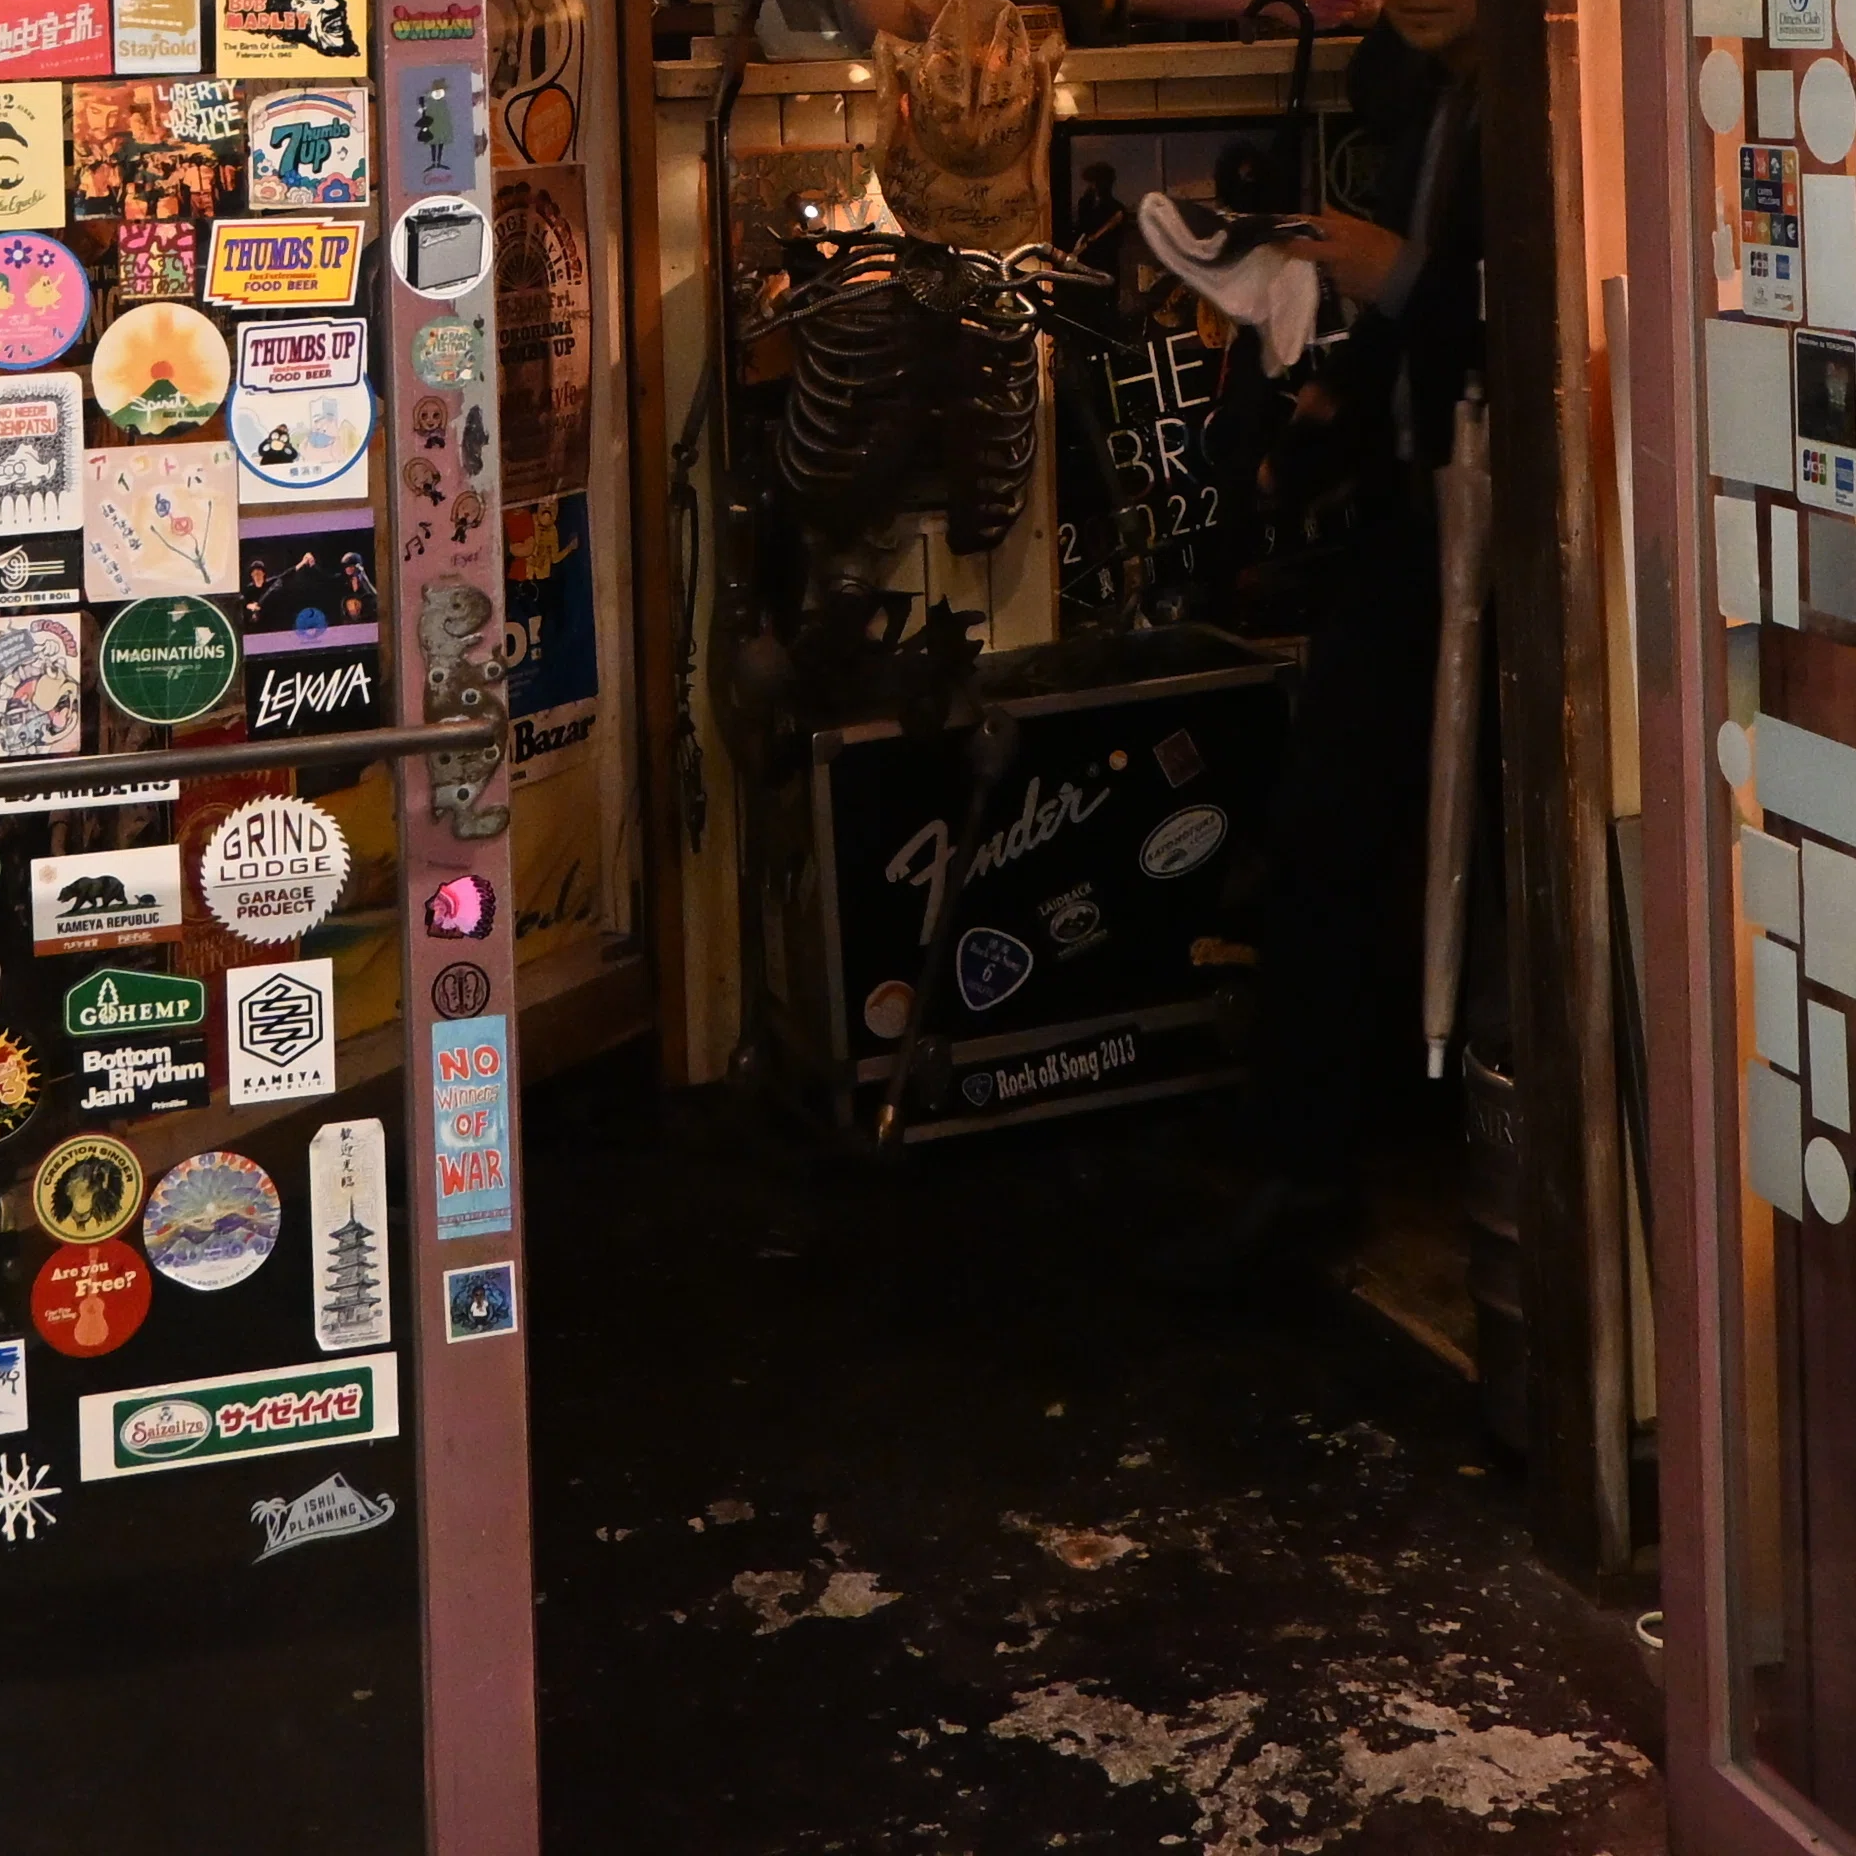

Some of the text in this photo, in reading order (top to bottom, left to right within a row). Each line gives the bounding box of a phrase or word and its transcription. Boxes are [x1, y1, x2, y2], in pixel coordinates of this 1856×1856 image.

[225, 12, 311, 30] MARLEY
[1779, 12, 1821, 24] Diners Club
[118, 40, 197, 59] StayGold
[157, 80, 237, 102] LIBERTY
[243, 279, 319, 292] FOOD BEER
[269, 369, 332, 383] FOOD BEER
[110, 644, 225, 663] IMAGINATIONS
[255, 662, 371, 729] LEYONA
[222, 808, 328, 860] GRIND
[220, 856, 332, 882] LODGE
[237, 886, 314, 905] GARAGE
[236, 900, 314, 919] PROJECT
[56, 912, 161, 934] KAMEYA REPUBLIC
[82, 1047, 172, 1073] Bottom
[438, 1044, 501, 1081] NO
[996, 1063, 1037, 1100] Rock
[1061, 1050, 1099, 1081] Song
[1102, 1035, 1137, 1070] 2013
[109, 1059, 205, 1090] Rhythm
[243, 1070, 322, 1089] KAMEYA
[81, 1088, 135, 1110] Jam
[455, 1111, 488, 1136] OF
[437, 1148, 506, 1198] WAR
[75, 1270, 137, 1298] Free?
[288, 1502, 358, 1533] PLANNING
